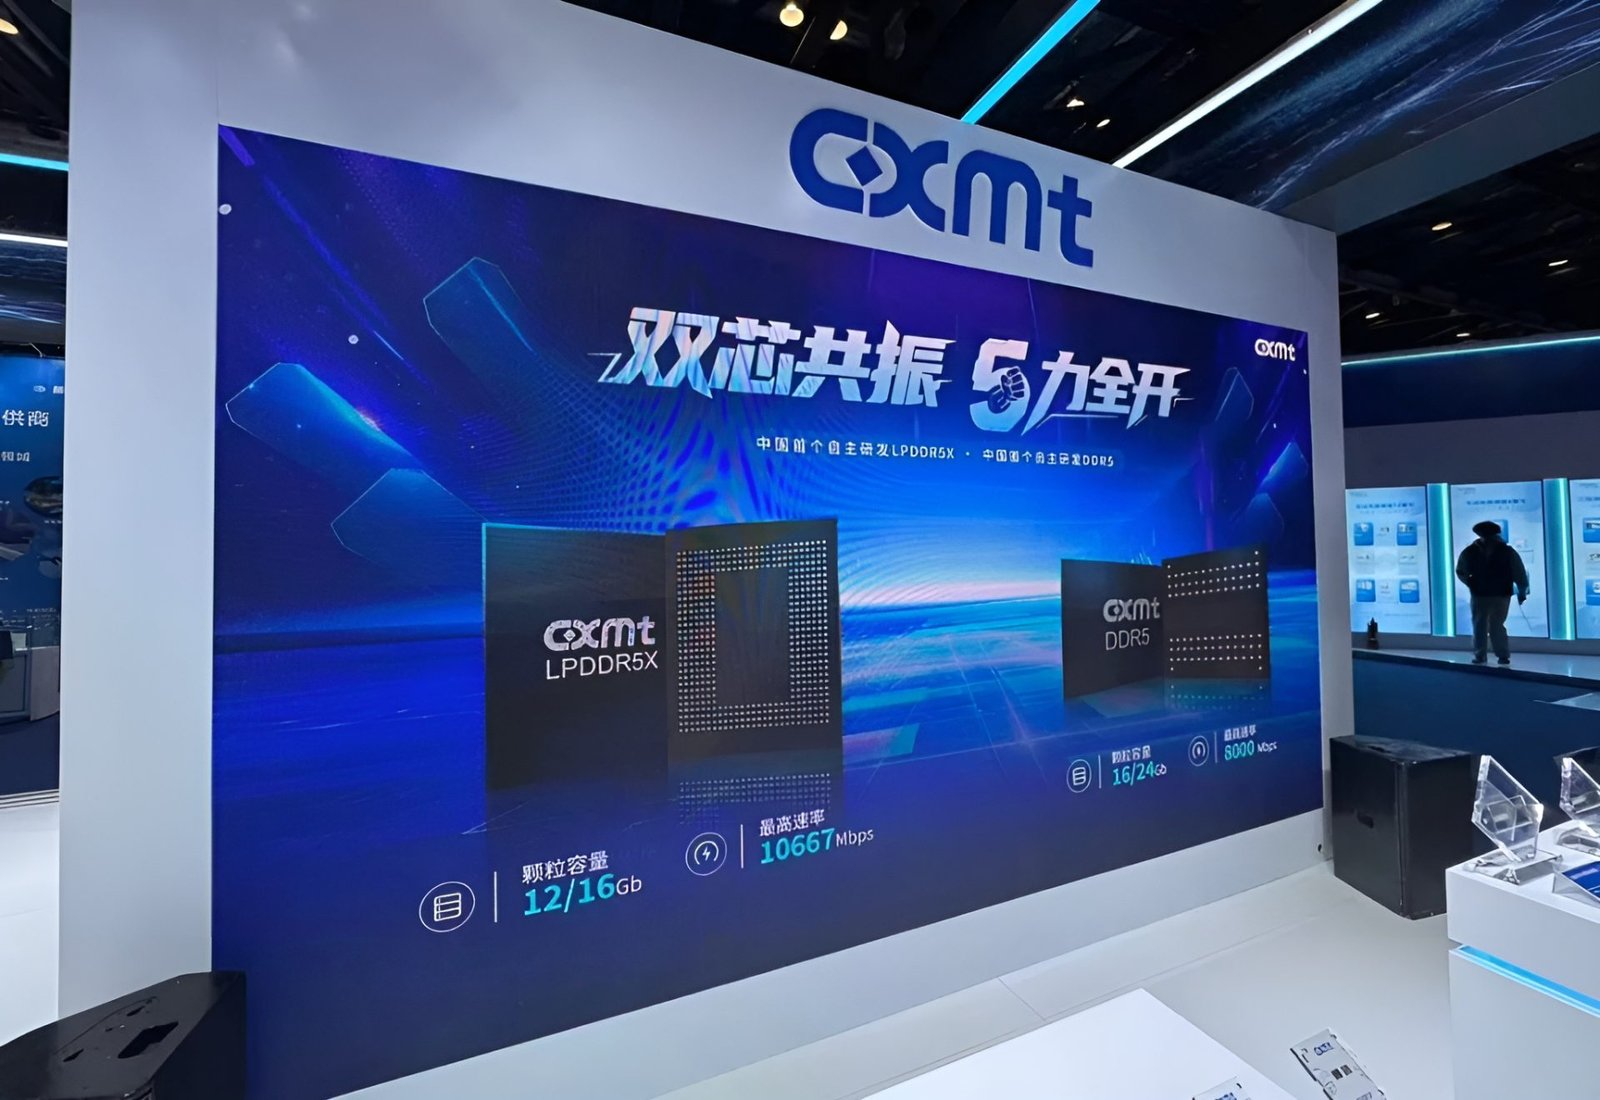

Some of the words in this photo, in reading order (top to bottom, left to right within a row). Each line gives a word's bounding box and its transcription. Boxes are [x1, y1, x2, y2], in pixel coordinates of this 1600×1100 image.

[599, 306, 956, 408] 双芯共振
[1105, 627, 1150, 651] DDR5
[546, 650, 659, 680] LPDDR5X
[521, 850, 609, 884] 颗粒容量
